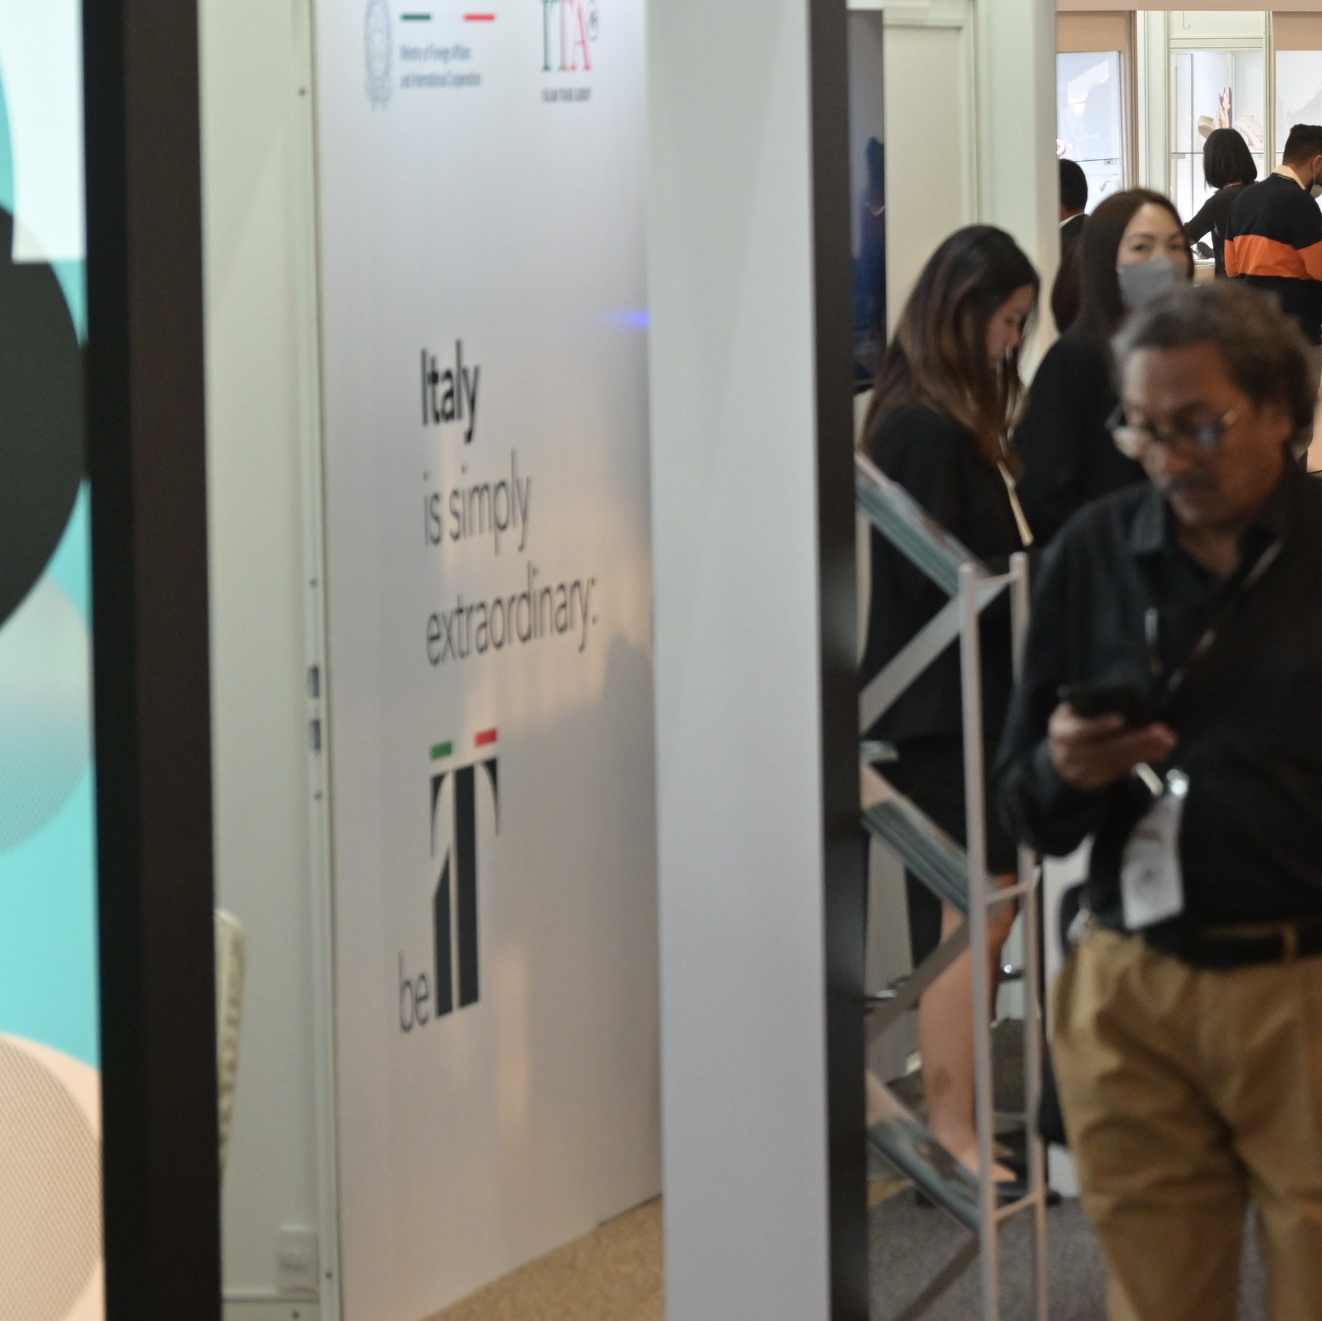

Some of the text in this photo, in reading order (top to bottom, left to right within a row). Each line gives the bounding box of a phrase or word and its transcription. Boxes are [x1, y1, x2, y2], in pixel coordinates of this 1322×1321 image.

[421, 339, 481, 444] Italy
[423, 447, 532, 557] is simply
[425, 562, 599, 668] extraordinary:
[398, 950, 431, 1036] be
